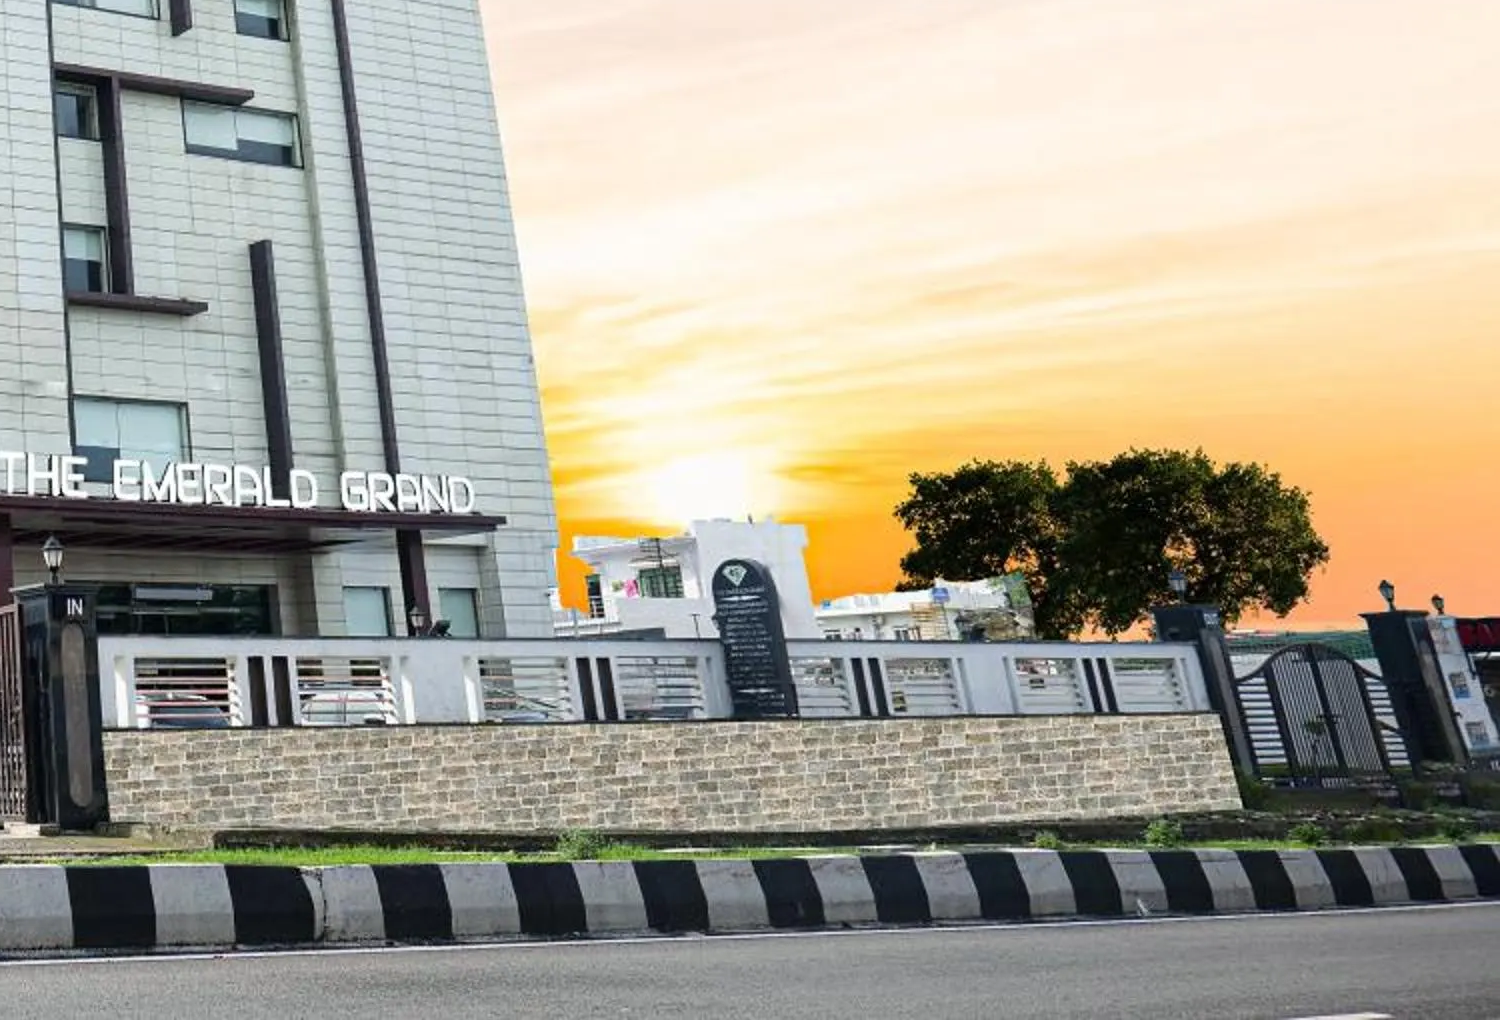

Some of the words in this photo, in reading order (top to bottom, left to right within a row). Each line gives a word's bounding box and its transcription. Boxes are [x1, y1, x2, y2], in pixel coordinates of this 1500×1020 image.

[113, 458, 319, 510] EMERALD
[341, 470, 475, 514] GRAND
[67, 598, 83, 616] IN
